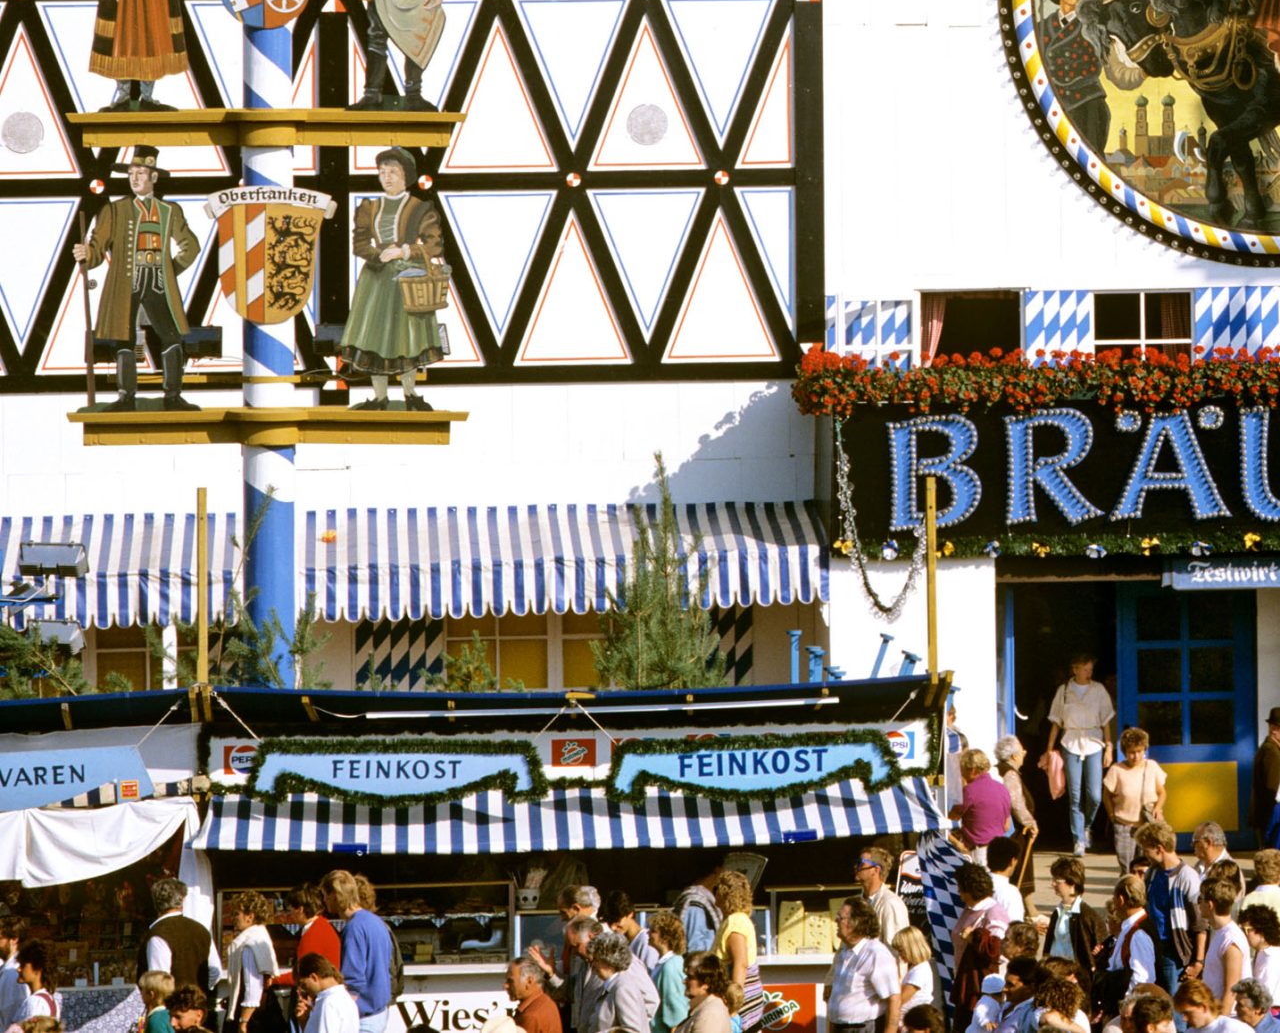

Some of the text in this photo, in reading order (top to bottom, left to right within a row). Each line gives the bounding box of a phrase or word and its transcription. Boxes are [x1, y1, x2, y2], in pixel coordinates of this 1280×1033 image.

[218, 187, 318, 205] Oberfranken
[332, 760, 462, 779] FEINKOST
[678, 748, 828, 778] FEINKOST
